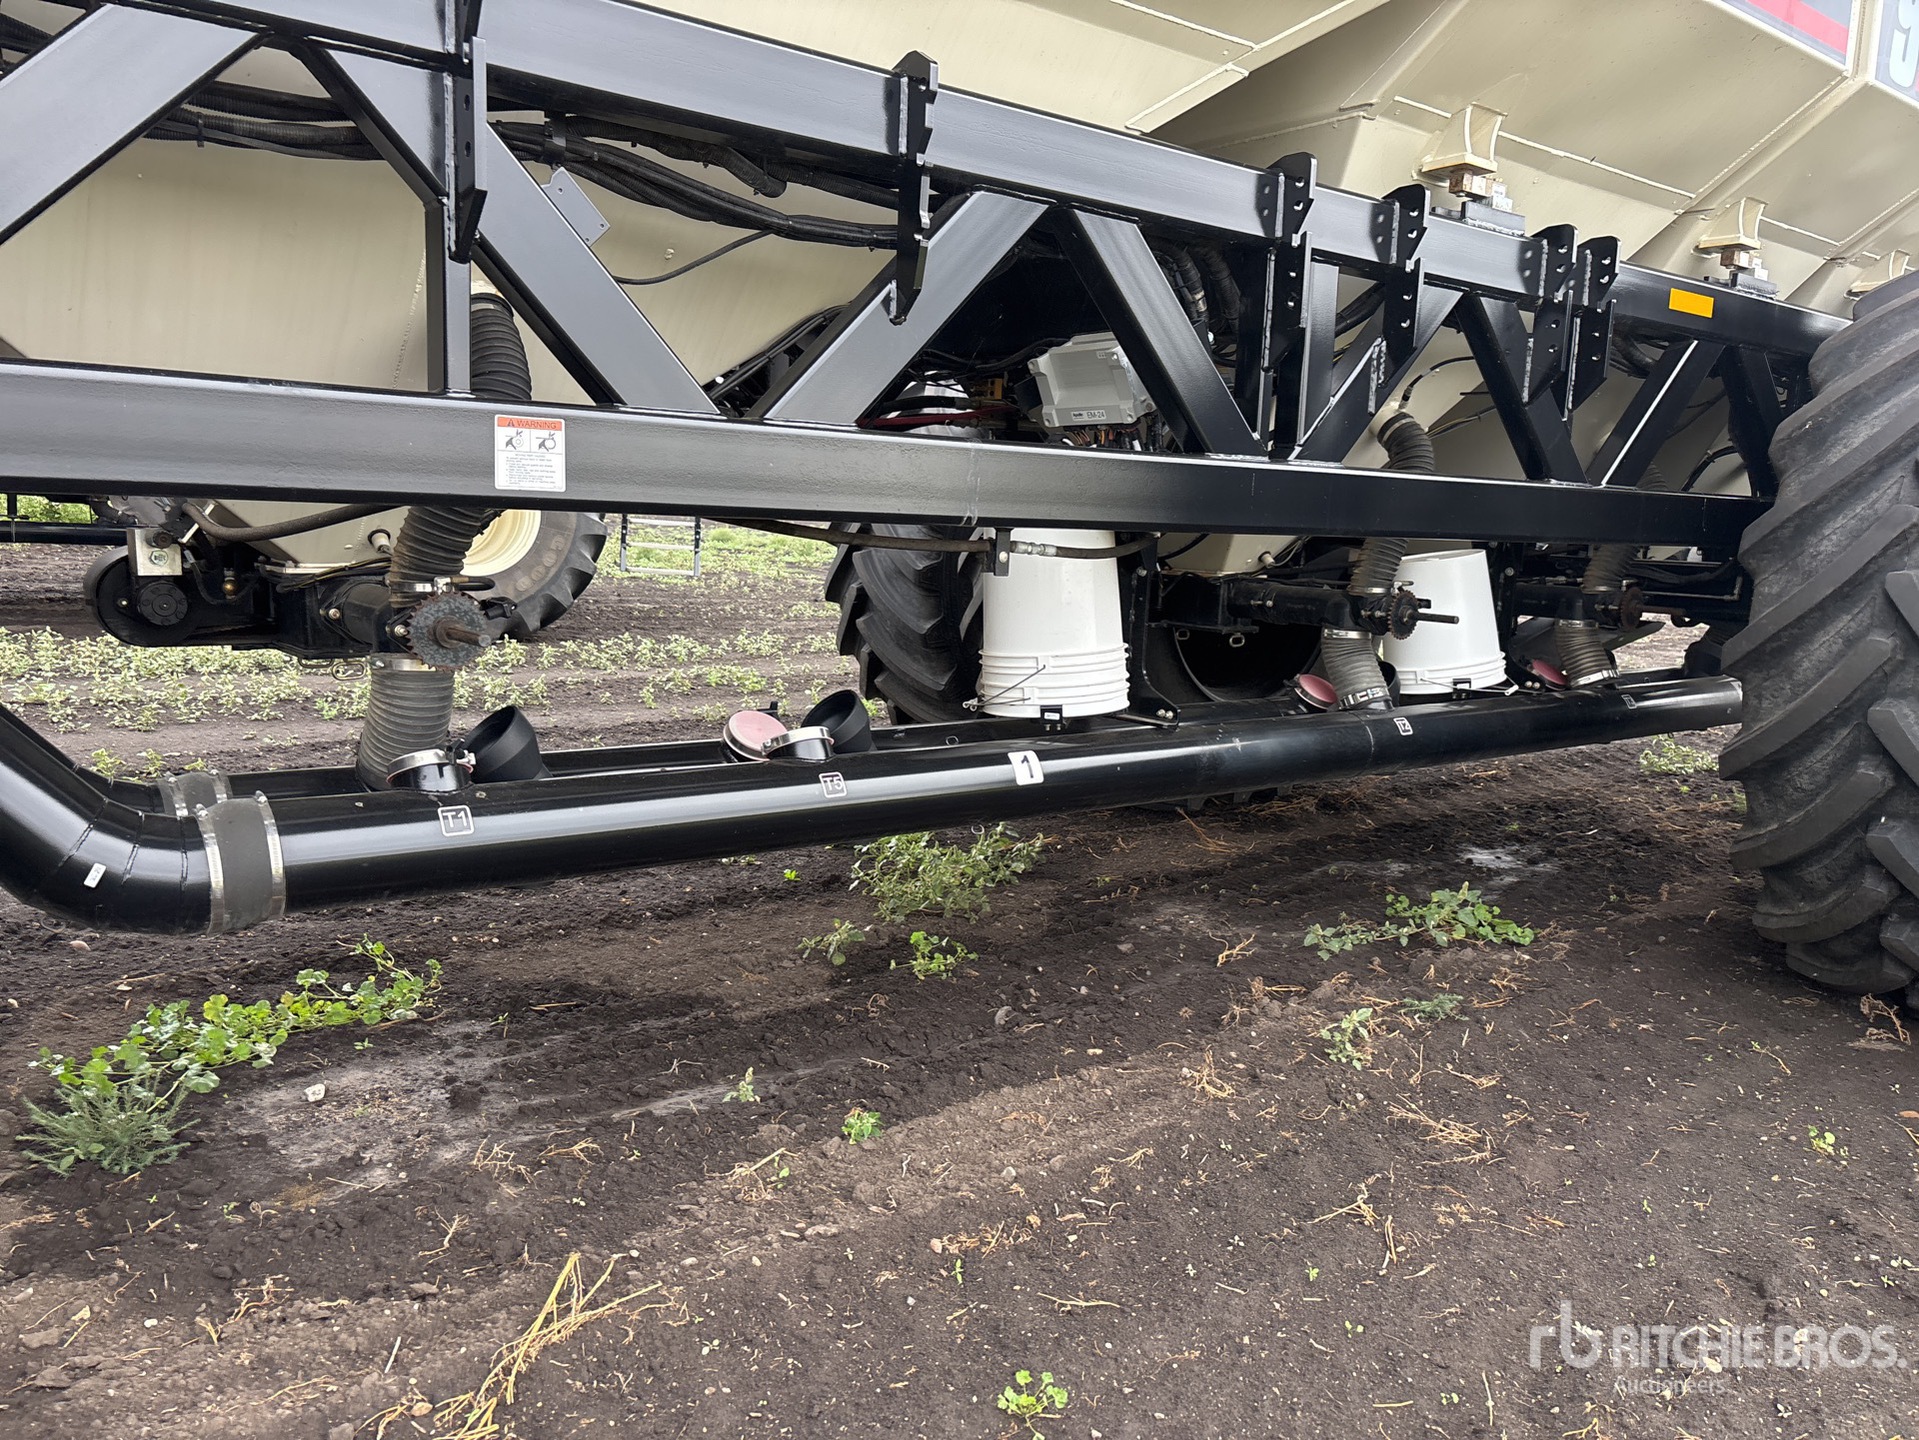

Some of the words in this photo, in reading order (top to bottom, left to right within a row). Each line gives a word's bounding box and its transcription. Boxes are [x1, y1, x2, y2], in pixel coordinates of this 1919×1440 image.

[517, 420, 557, 430] WARNING
[1021, 755, 1034, 778] 1
[823, 776, 843, 791] T5
[442, 810, 467, 828] T1
